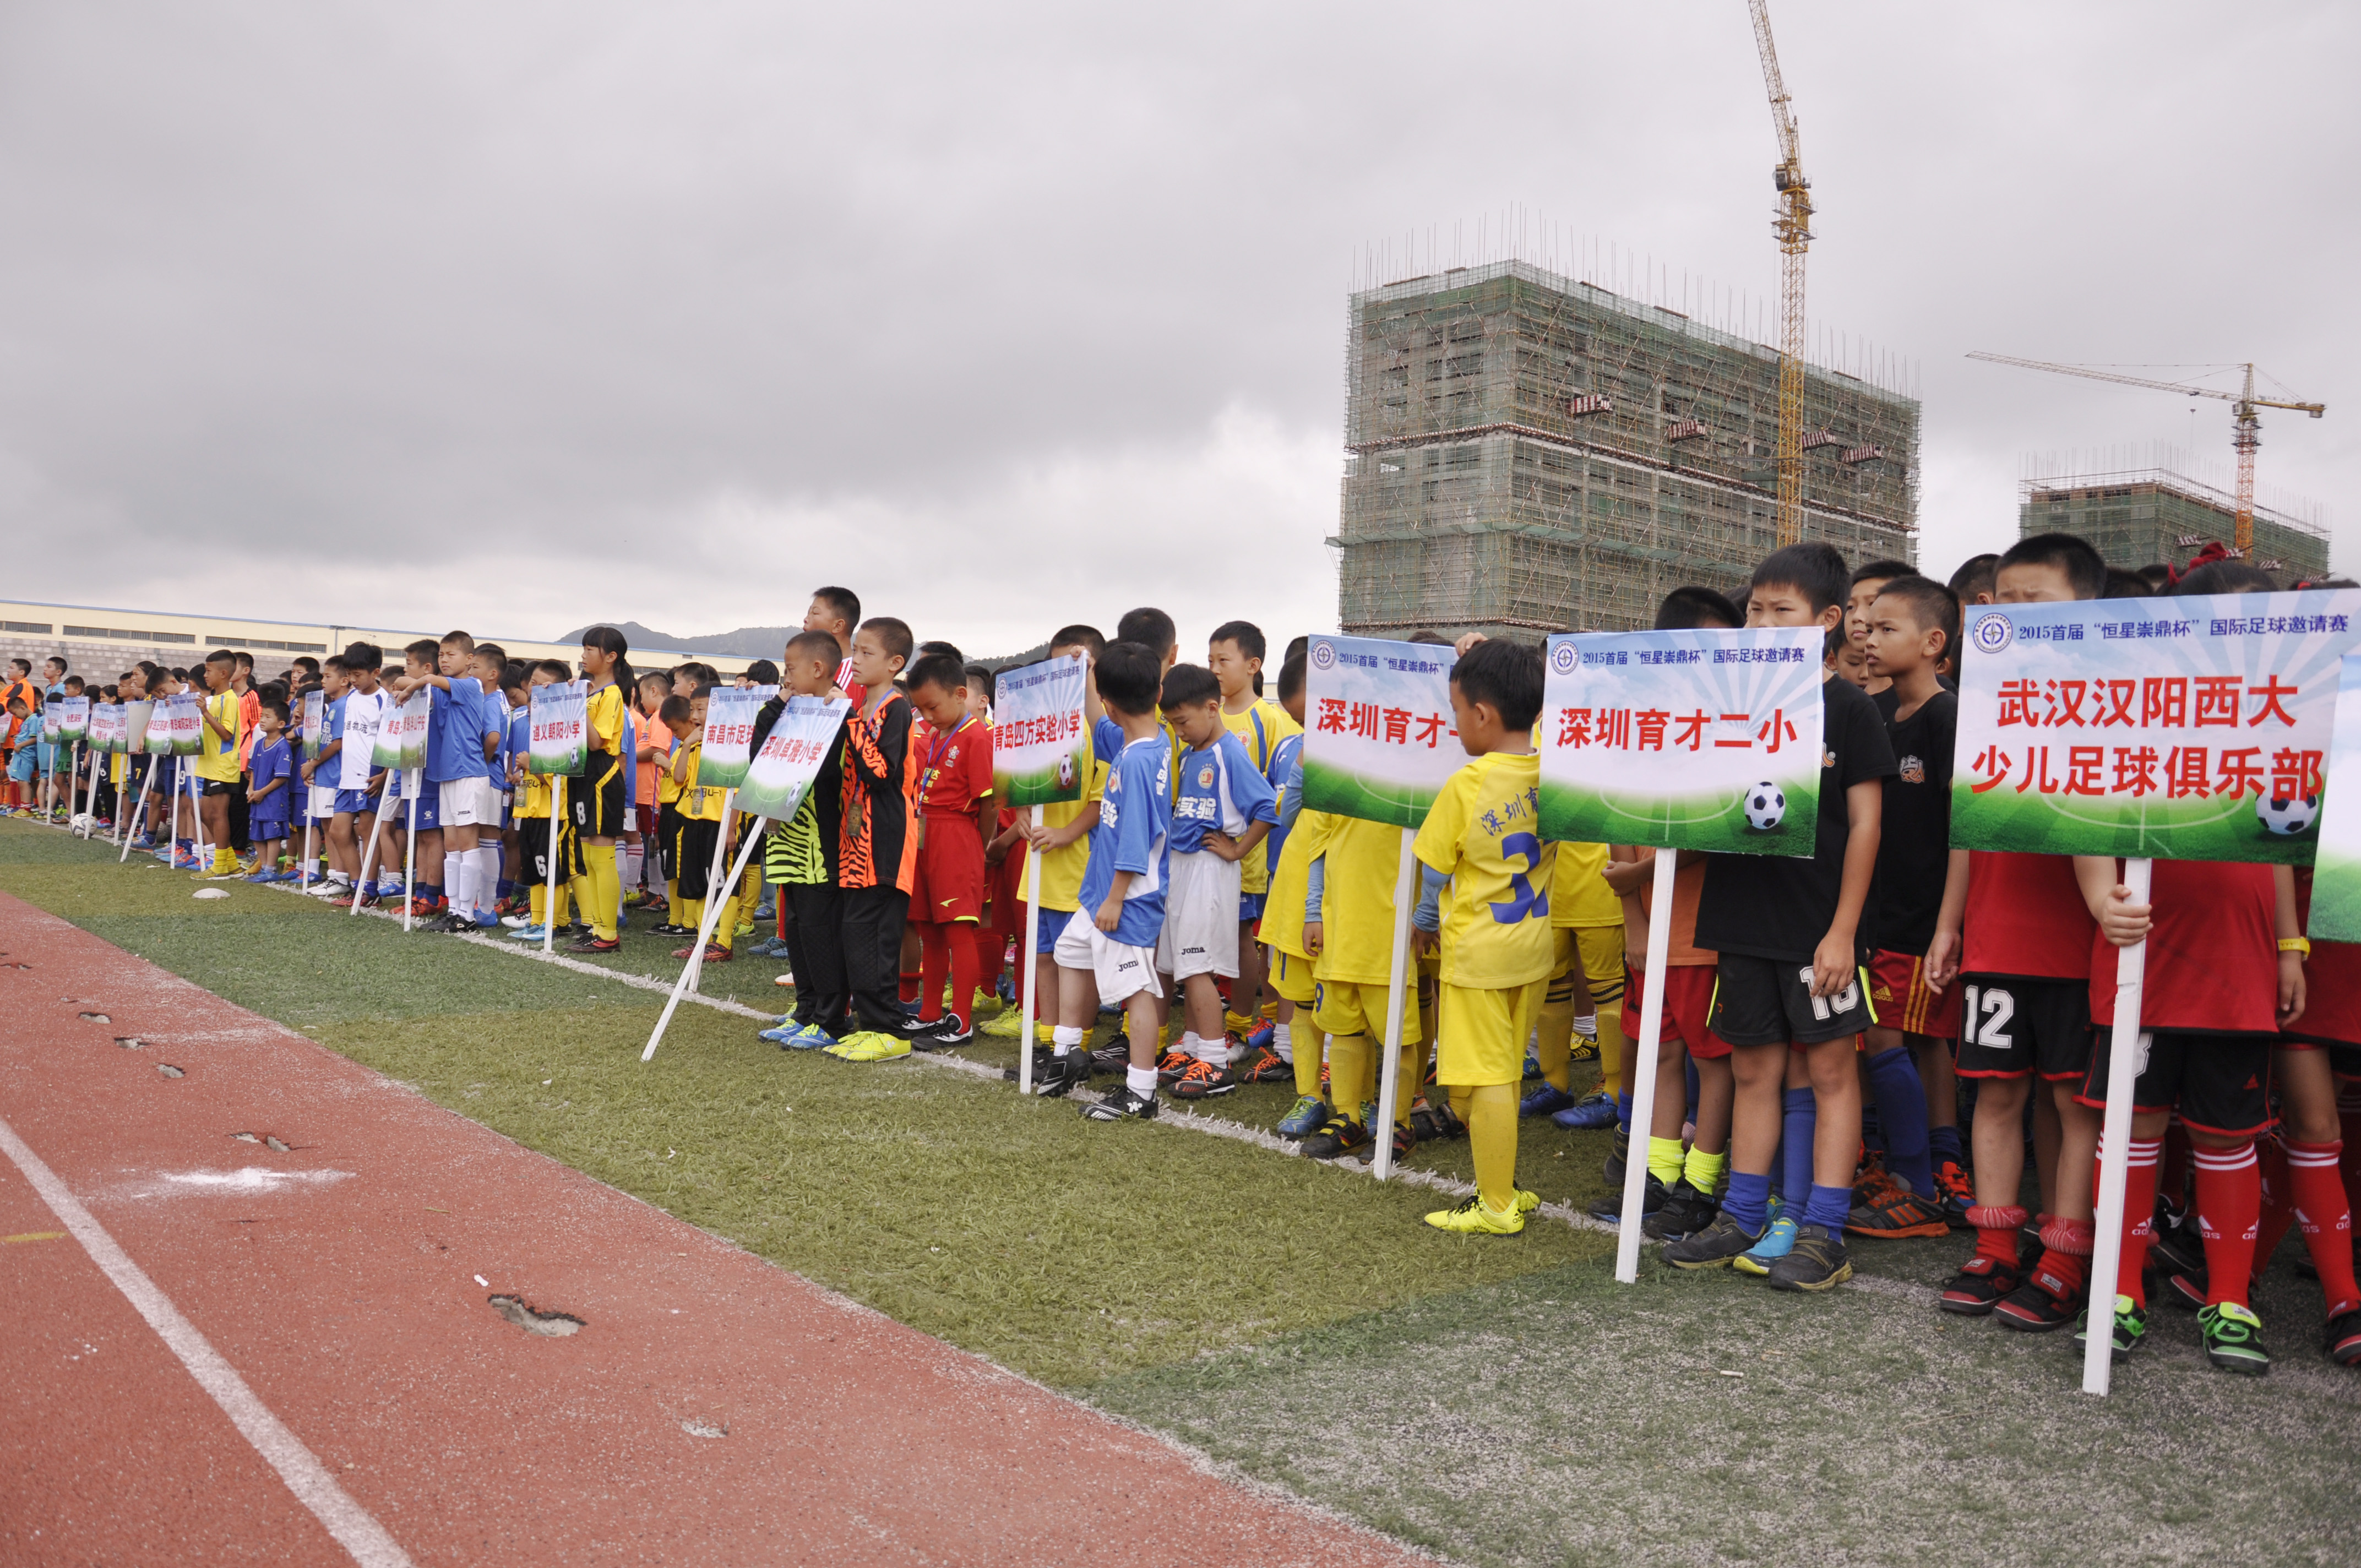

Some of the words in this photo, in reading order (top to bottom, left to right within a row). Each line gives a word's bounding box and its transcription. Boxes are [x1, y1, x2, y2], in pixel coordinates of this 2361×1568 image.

[1997, 674, 2298, 727] 武汉汉阳西大
[533, 720, 580, 741] 遵义朝阳小学
[994, 709, 1080, 752] 青岛四方实验小学
[1557, 708, 1798, 753] 深圳育才二小
[1971, 745, 2324, 801] 少儿足球俱乐部
[576, 801, 586, 825] 8
[535, 854, 547, 877] 6
[1315, 982, 1324, 1013] 9
[1872, 993, 1894, 1003] adidas
[1965, 984, 2014, 1048] 12
